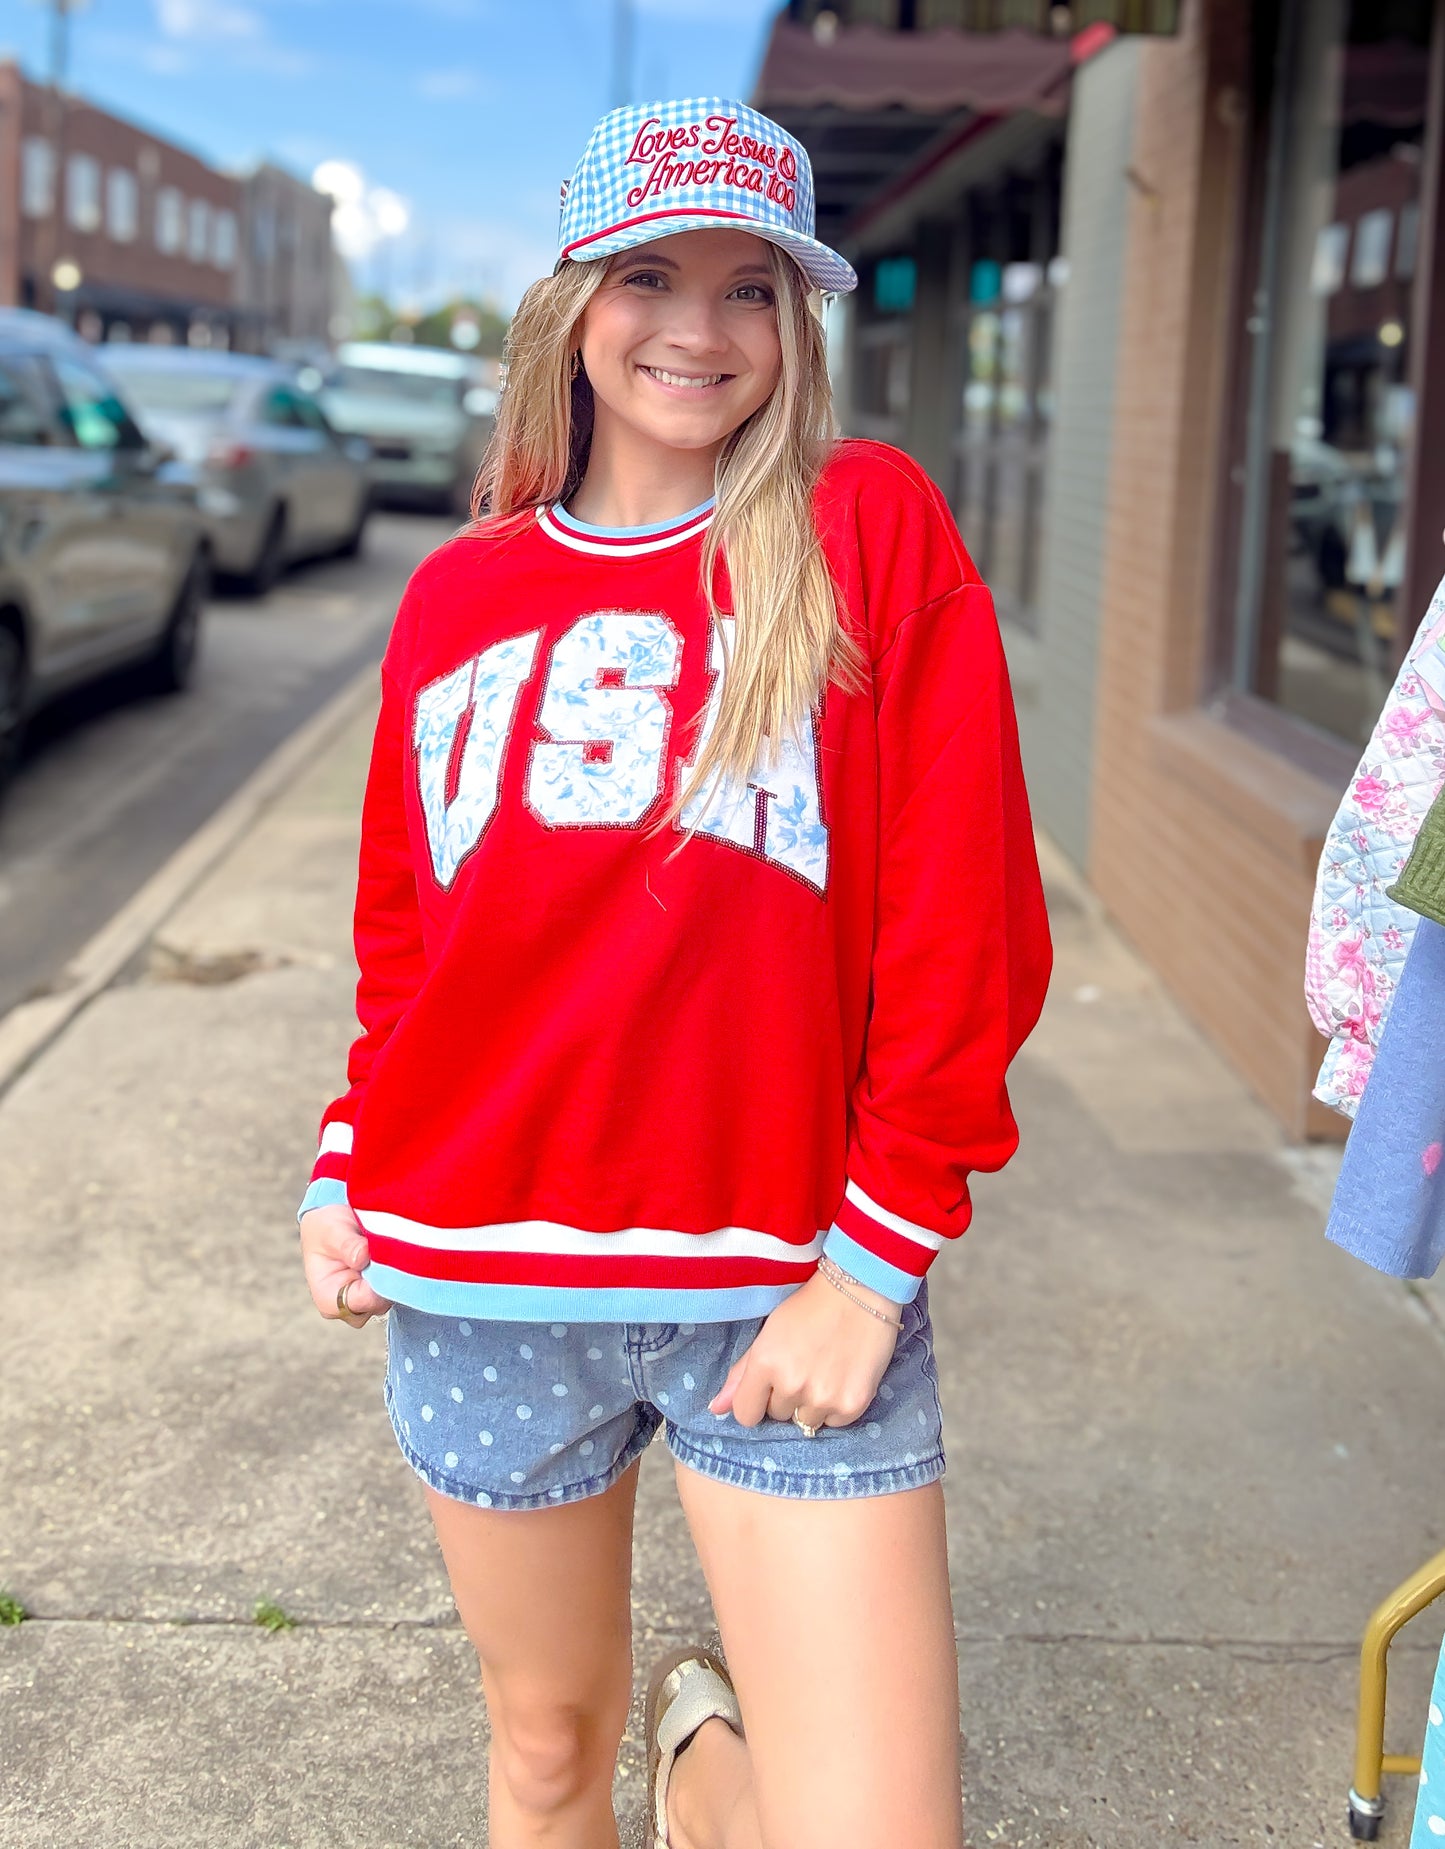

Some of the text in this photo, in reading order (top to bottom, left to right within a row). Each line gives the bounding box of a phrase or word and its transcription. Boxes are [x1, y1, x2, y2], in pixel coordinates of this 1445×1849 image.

[624, 117, 701, 166] Loves
[701, 115, 776, 169] Jesus
[627, 150, 796, 211] America too
